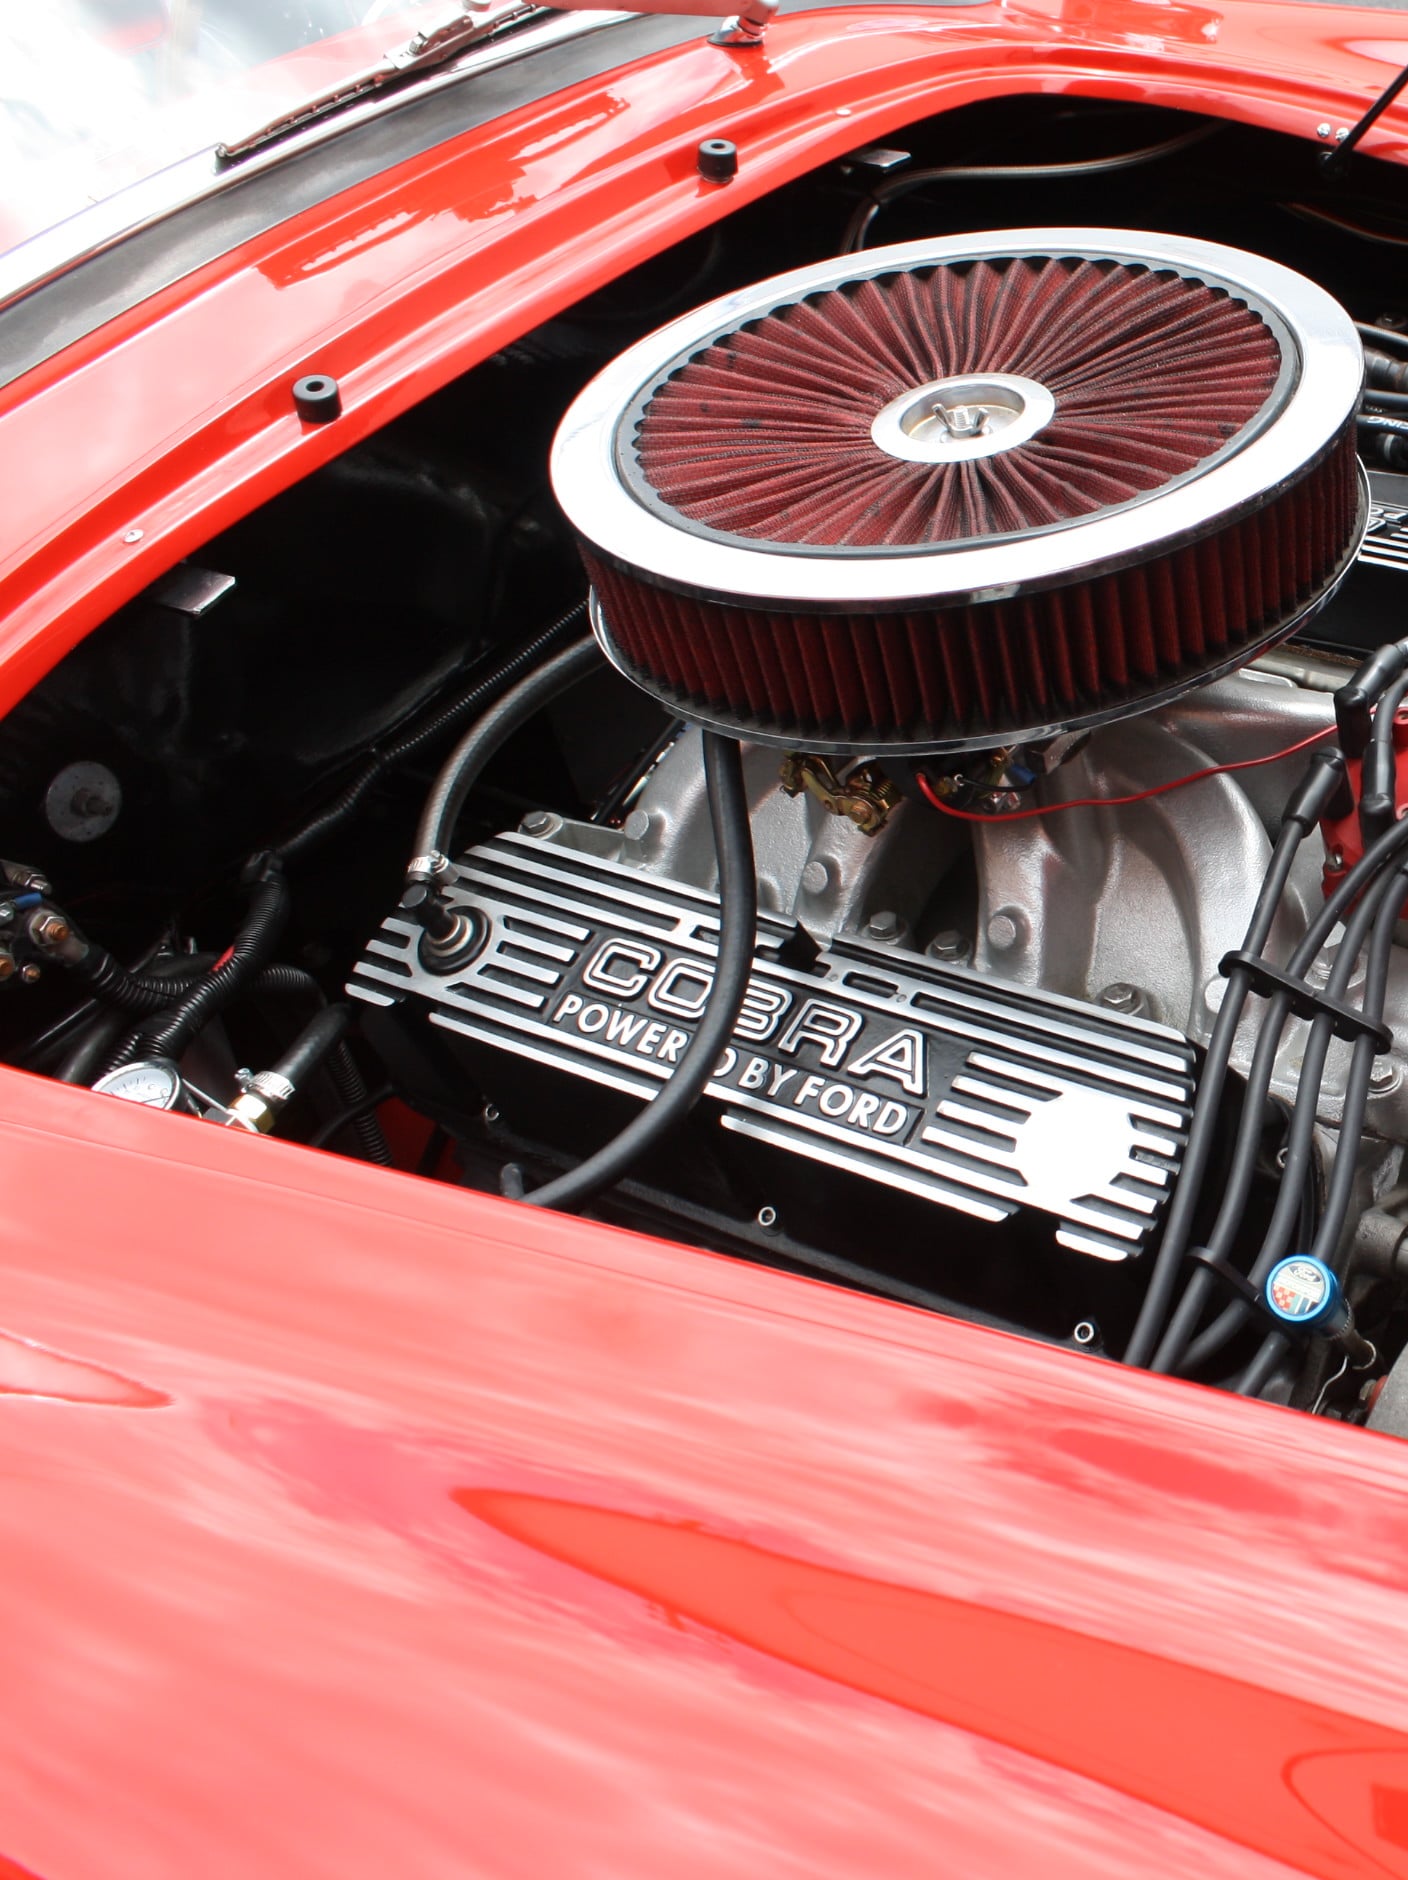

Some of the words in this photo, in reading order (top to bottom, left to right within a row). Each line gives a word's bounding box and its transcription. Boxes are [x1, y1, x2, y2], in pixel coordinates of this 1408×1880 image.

[552, 994, 739, 1078] POWERD
[738, 1054, 798, 1098] BY
[793, 1075, 909, 1136] FORD
[582, 937, 928, 1097] COBRA
